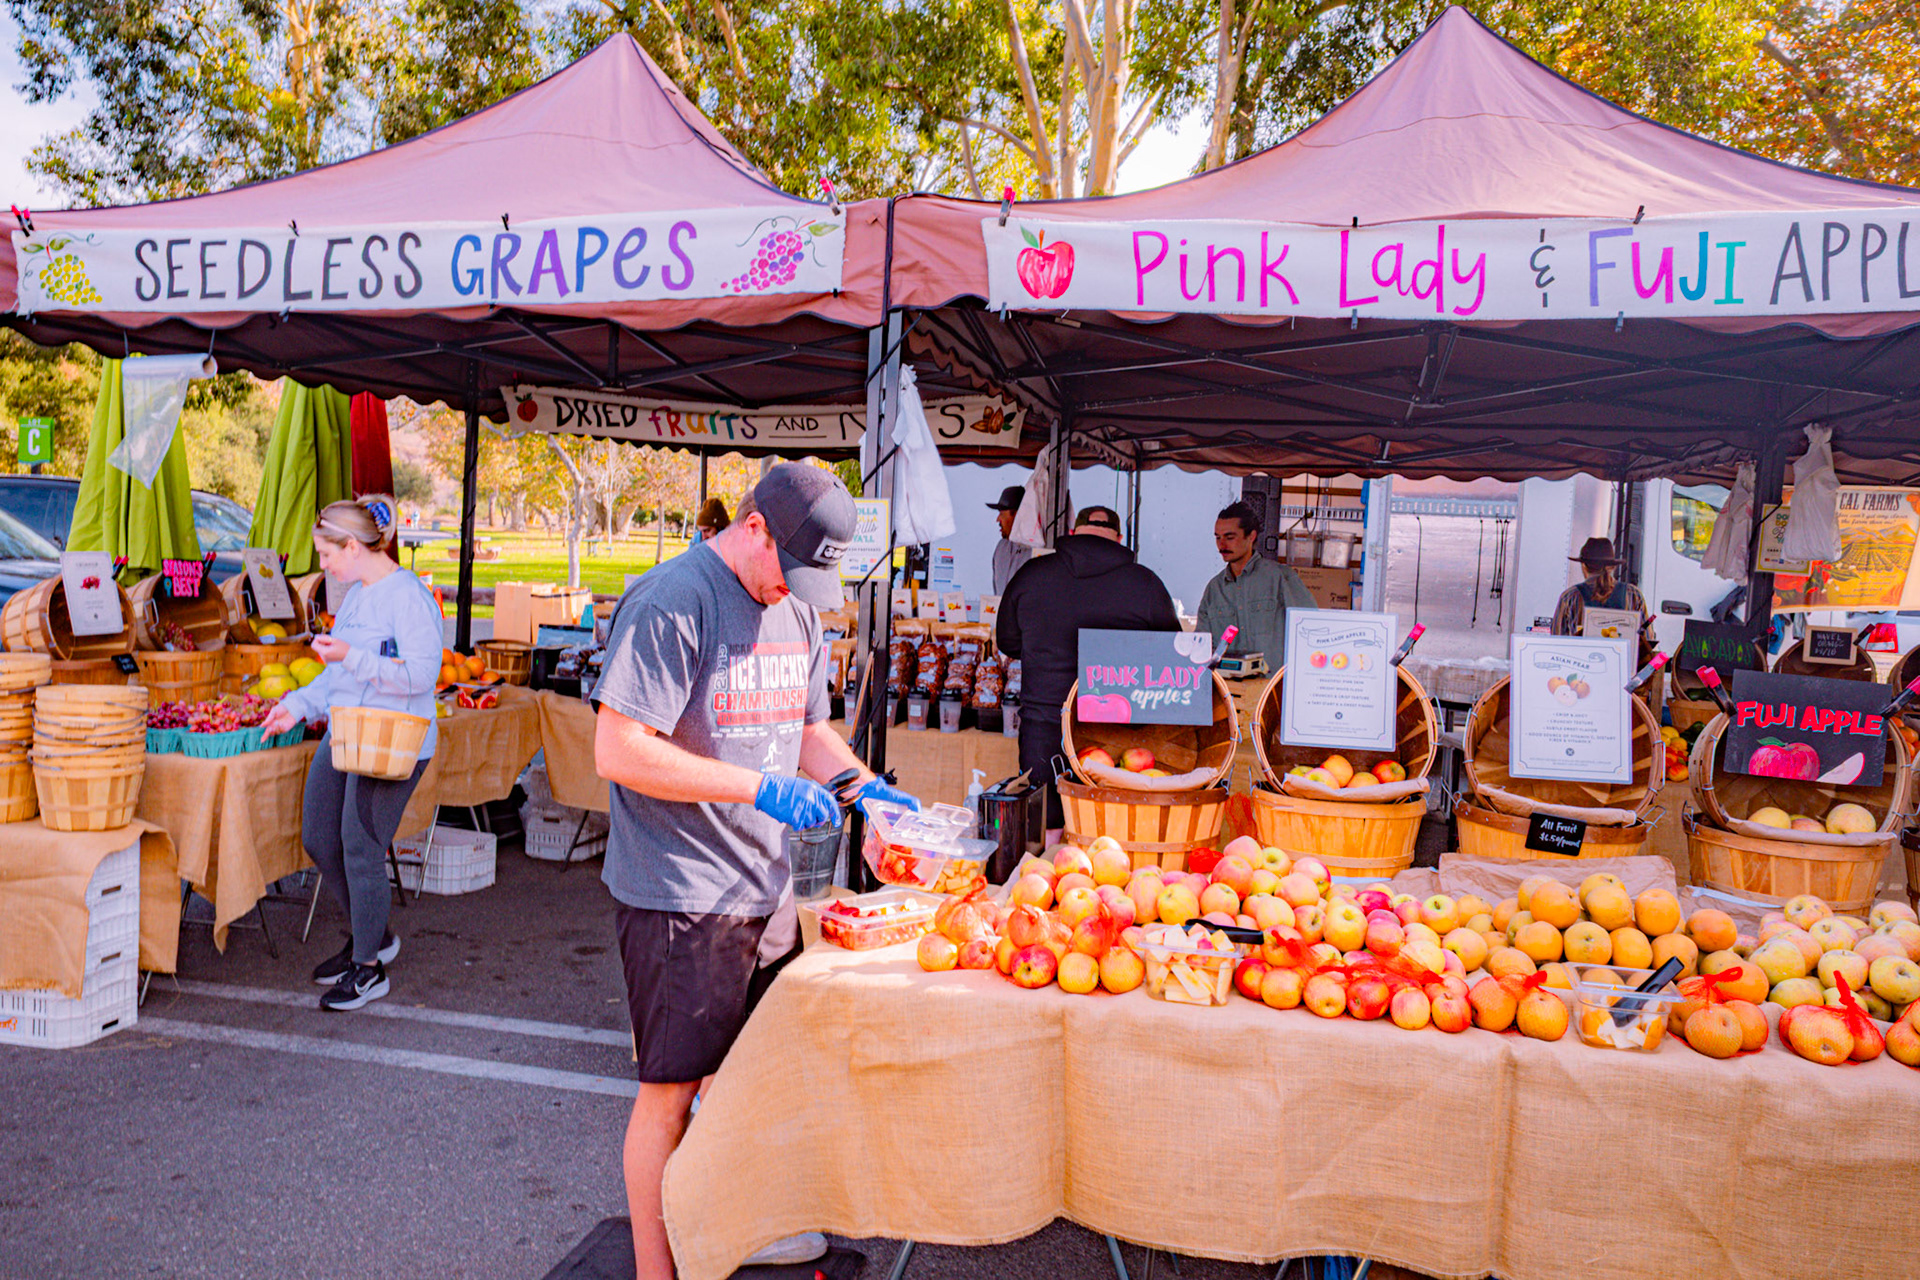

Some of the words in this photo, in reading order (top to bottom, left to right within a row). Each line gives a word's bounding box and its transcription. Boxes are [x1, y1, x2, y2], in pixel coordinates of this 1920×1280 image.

[134, 232, 423, 301] SEEDLESS
[1132, 229, 1300, 308] Pink
[1339, 224, 1487, 317] Lady
[1529, 229, 1556, 308] &
[555, 396, 638, 428] DRIED
[774, 416, 819, 432] AND
[840, 404, 965, 440] NS
[28, 428, 40, 456] C
[1840, 492, 1860, 511] CAL
[1862, 493, 1902, 511] FARMS
[172, 577, 200, 597] BEST
[730, 656, 756, 690] ICE
[760, 654, 808, 689] HOCKEY
[1551, 656, 1571, 664] ASIAN
[1573, 661, 1590, 669] PEAR
[1086, 664, 1139, 689] PINK
[1144, 664, 1206, 690] LADY
[713, 688, 807, 712] CHAMPIONSHI
[1130, 688, 1193, 710] apples
[1736, 701, 1796, 729] FUJI
[1800, 705, 1883, 737] APPLE
[1540, 818, 1554, 830] All
[1556, 821, 1578, 833] Fruit
